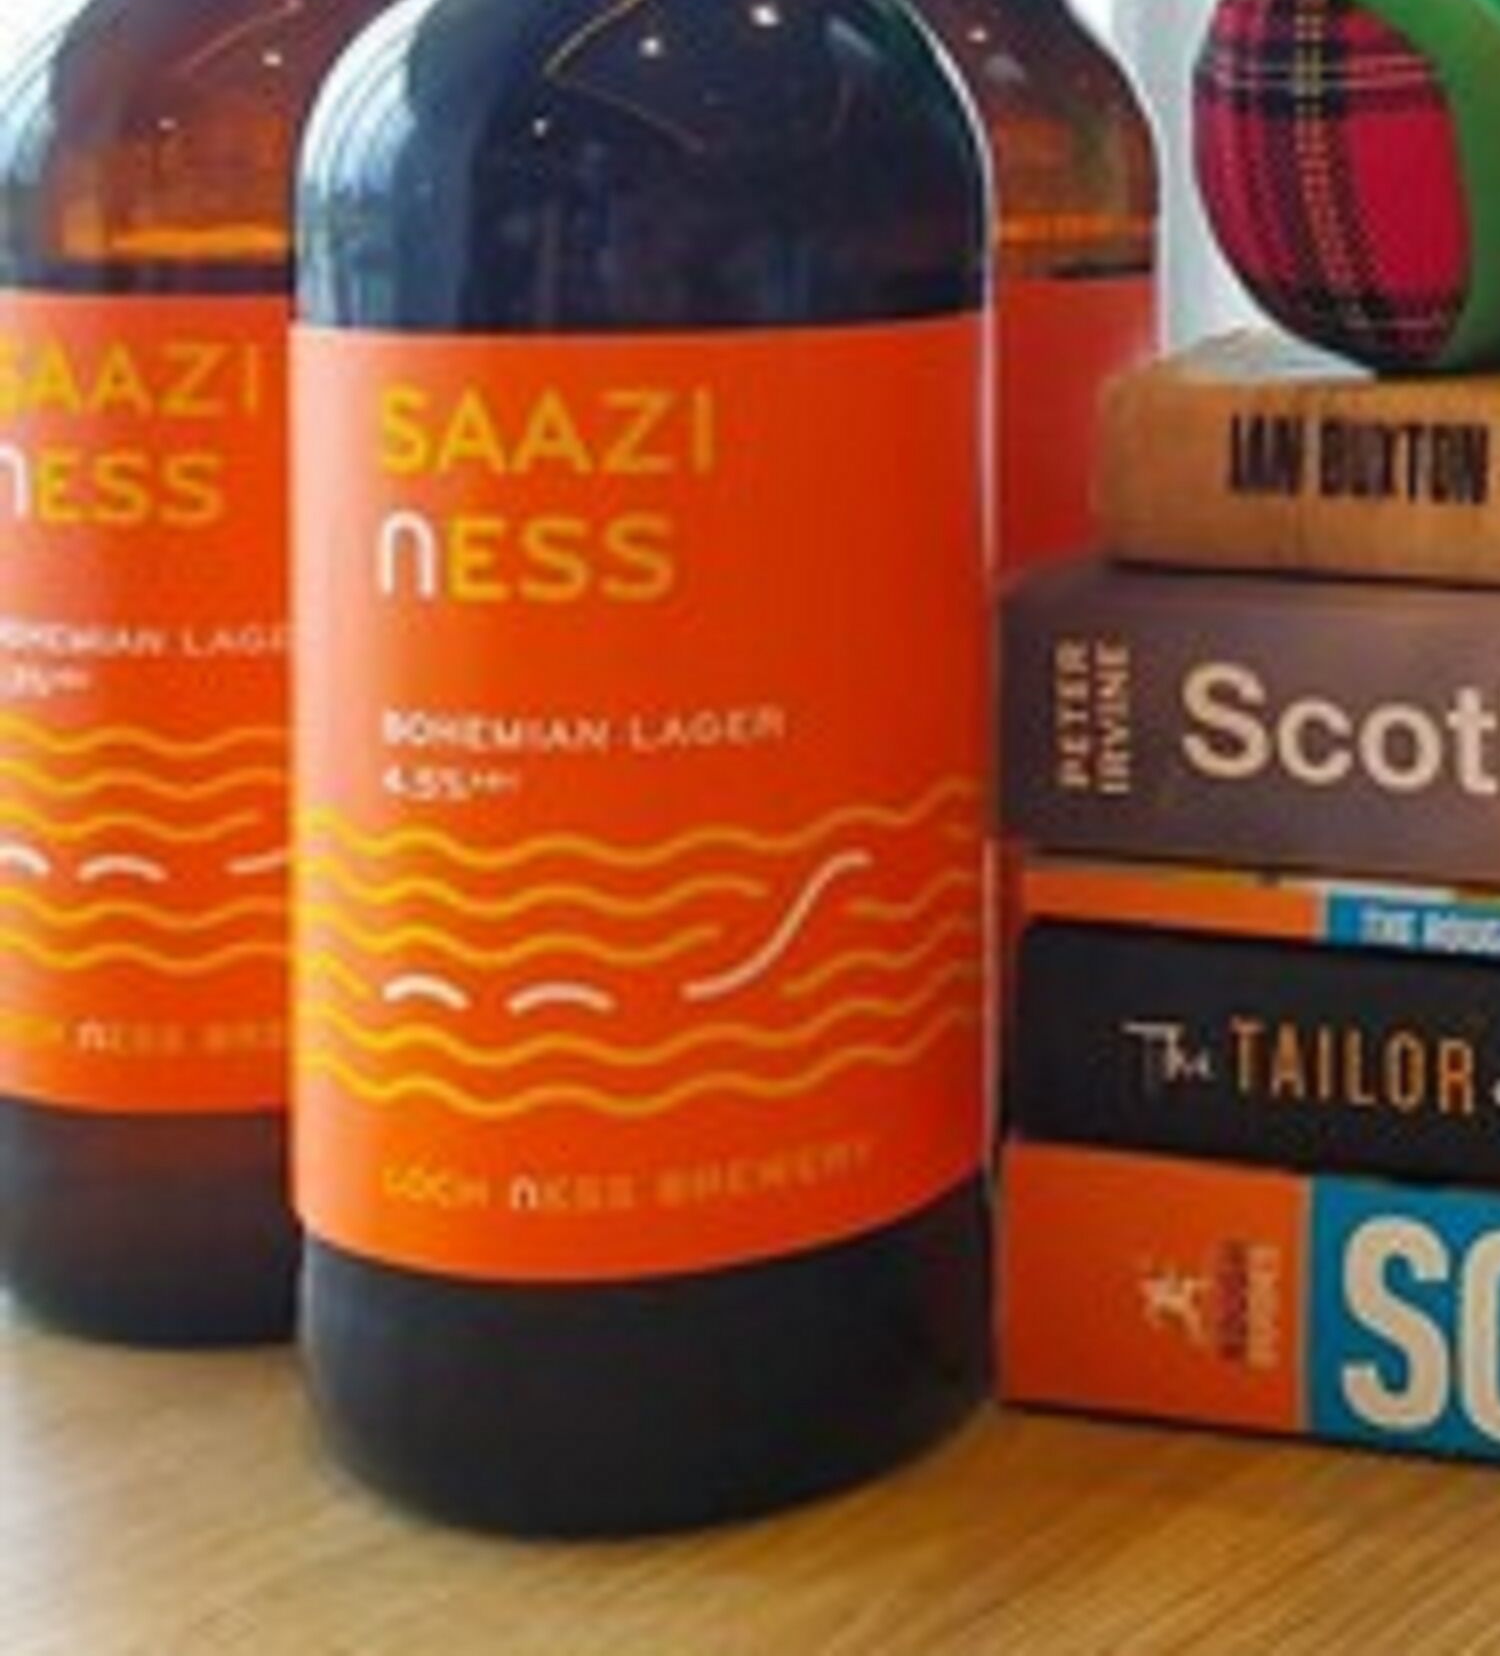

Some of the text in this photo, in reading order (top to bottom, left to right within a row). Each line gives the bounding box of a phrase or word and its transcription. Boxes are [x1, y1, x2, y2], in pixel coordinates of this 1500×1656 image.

[379, 385, 714, 476] SAAZI
[1229, 416, 1300, 497] IAN
[1319, 419, 1488, 504] BUXTON
[382, 704, 785, 753] BOHEMIAN LAGER
[1055, 640, 1089, 787] PETER
[1096, 641, 1132, 794] IRVINE
[1358, 907, 1416, 947] THE
[1229, 1014, 1477, 1116] TAILOR
